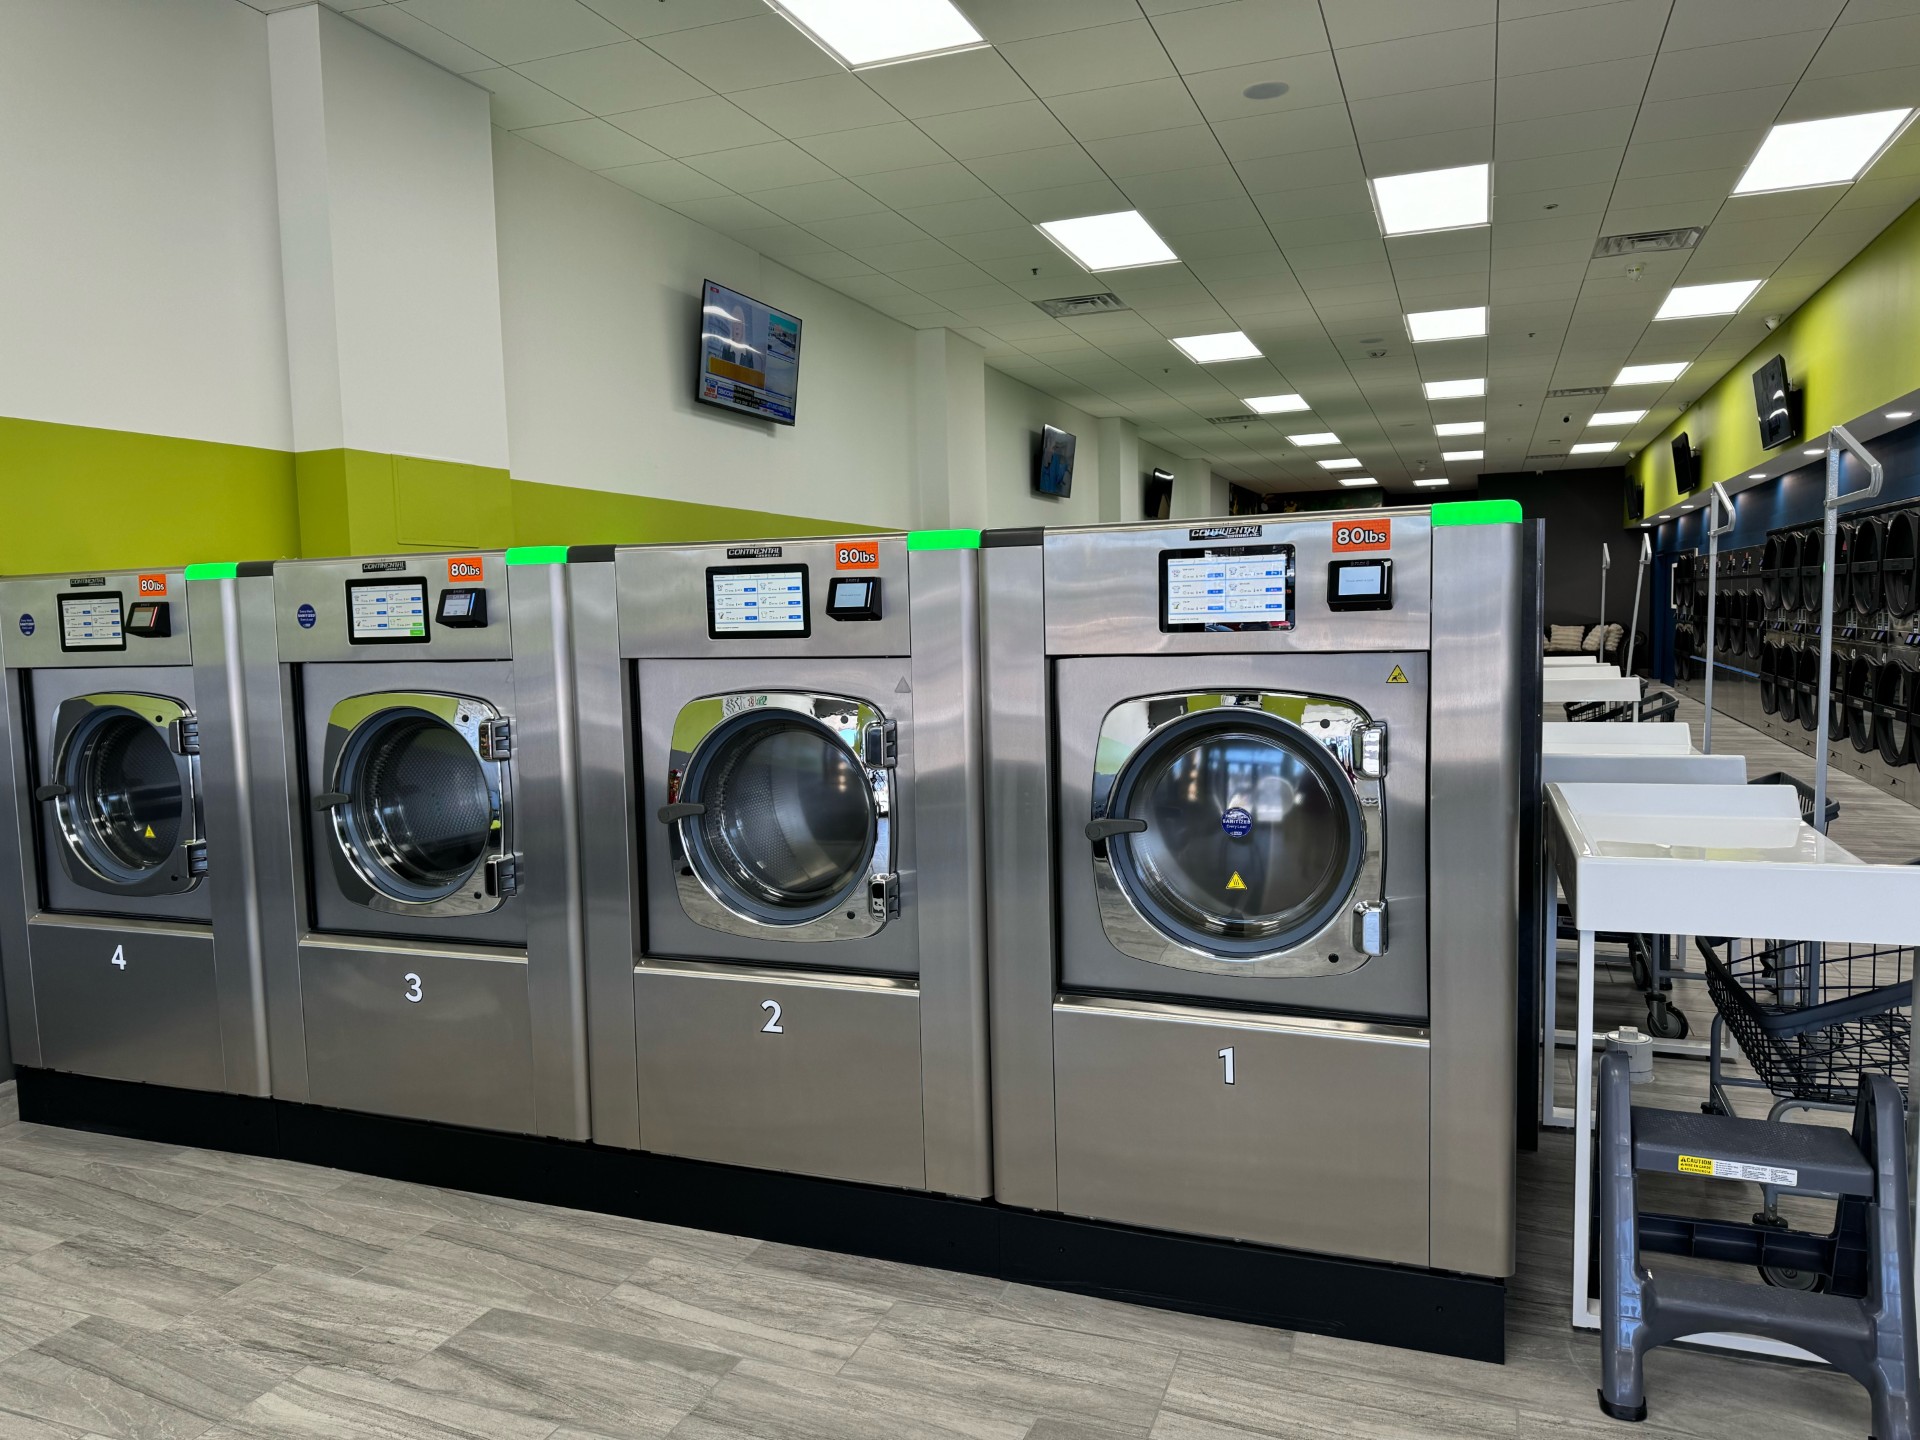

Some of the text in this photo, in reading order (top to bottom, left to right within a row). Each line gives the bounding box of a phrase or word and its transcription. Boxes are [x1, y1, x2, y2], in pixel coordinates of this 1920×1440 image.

[1336, 527, 1387, 545] 80lbs
[728, 547, 780, 556] CONTINENTAL
[839, 549, 876, 564] 80lbs
[450, 563, 481, 577] 80lbs
[141, 579, 165, 592] 80lbs
[111, 944, 127, 970] 4
[404, 972, 423, 1003] 3
[760, 999, 783, 1034] 2
[1218, 1046, 1235, 1085] 1
[1686, 1157, 1712, 1166] CAUTION
